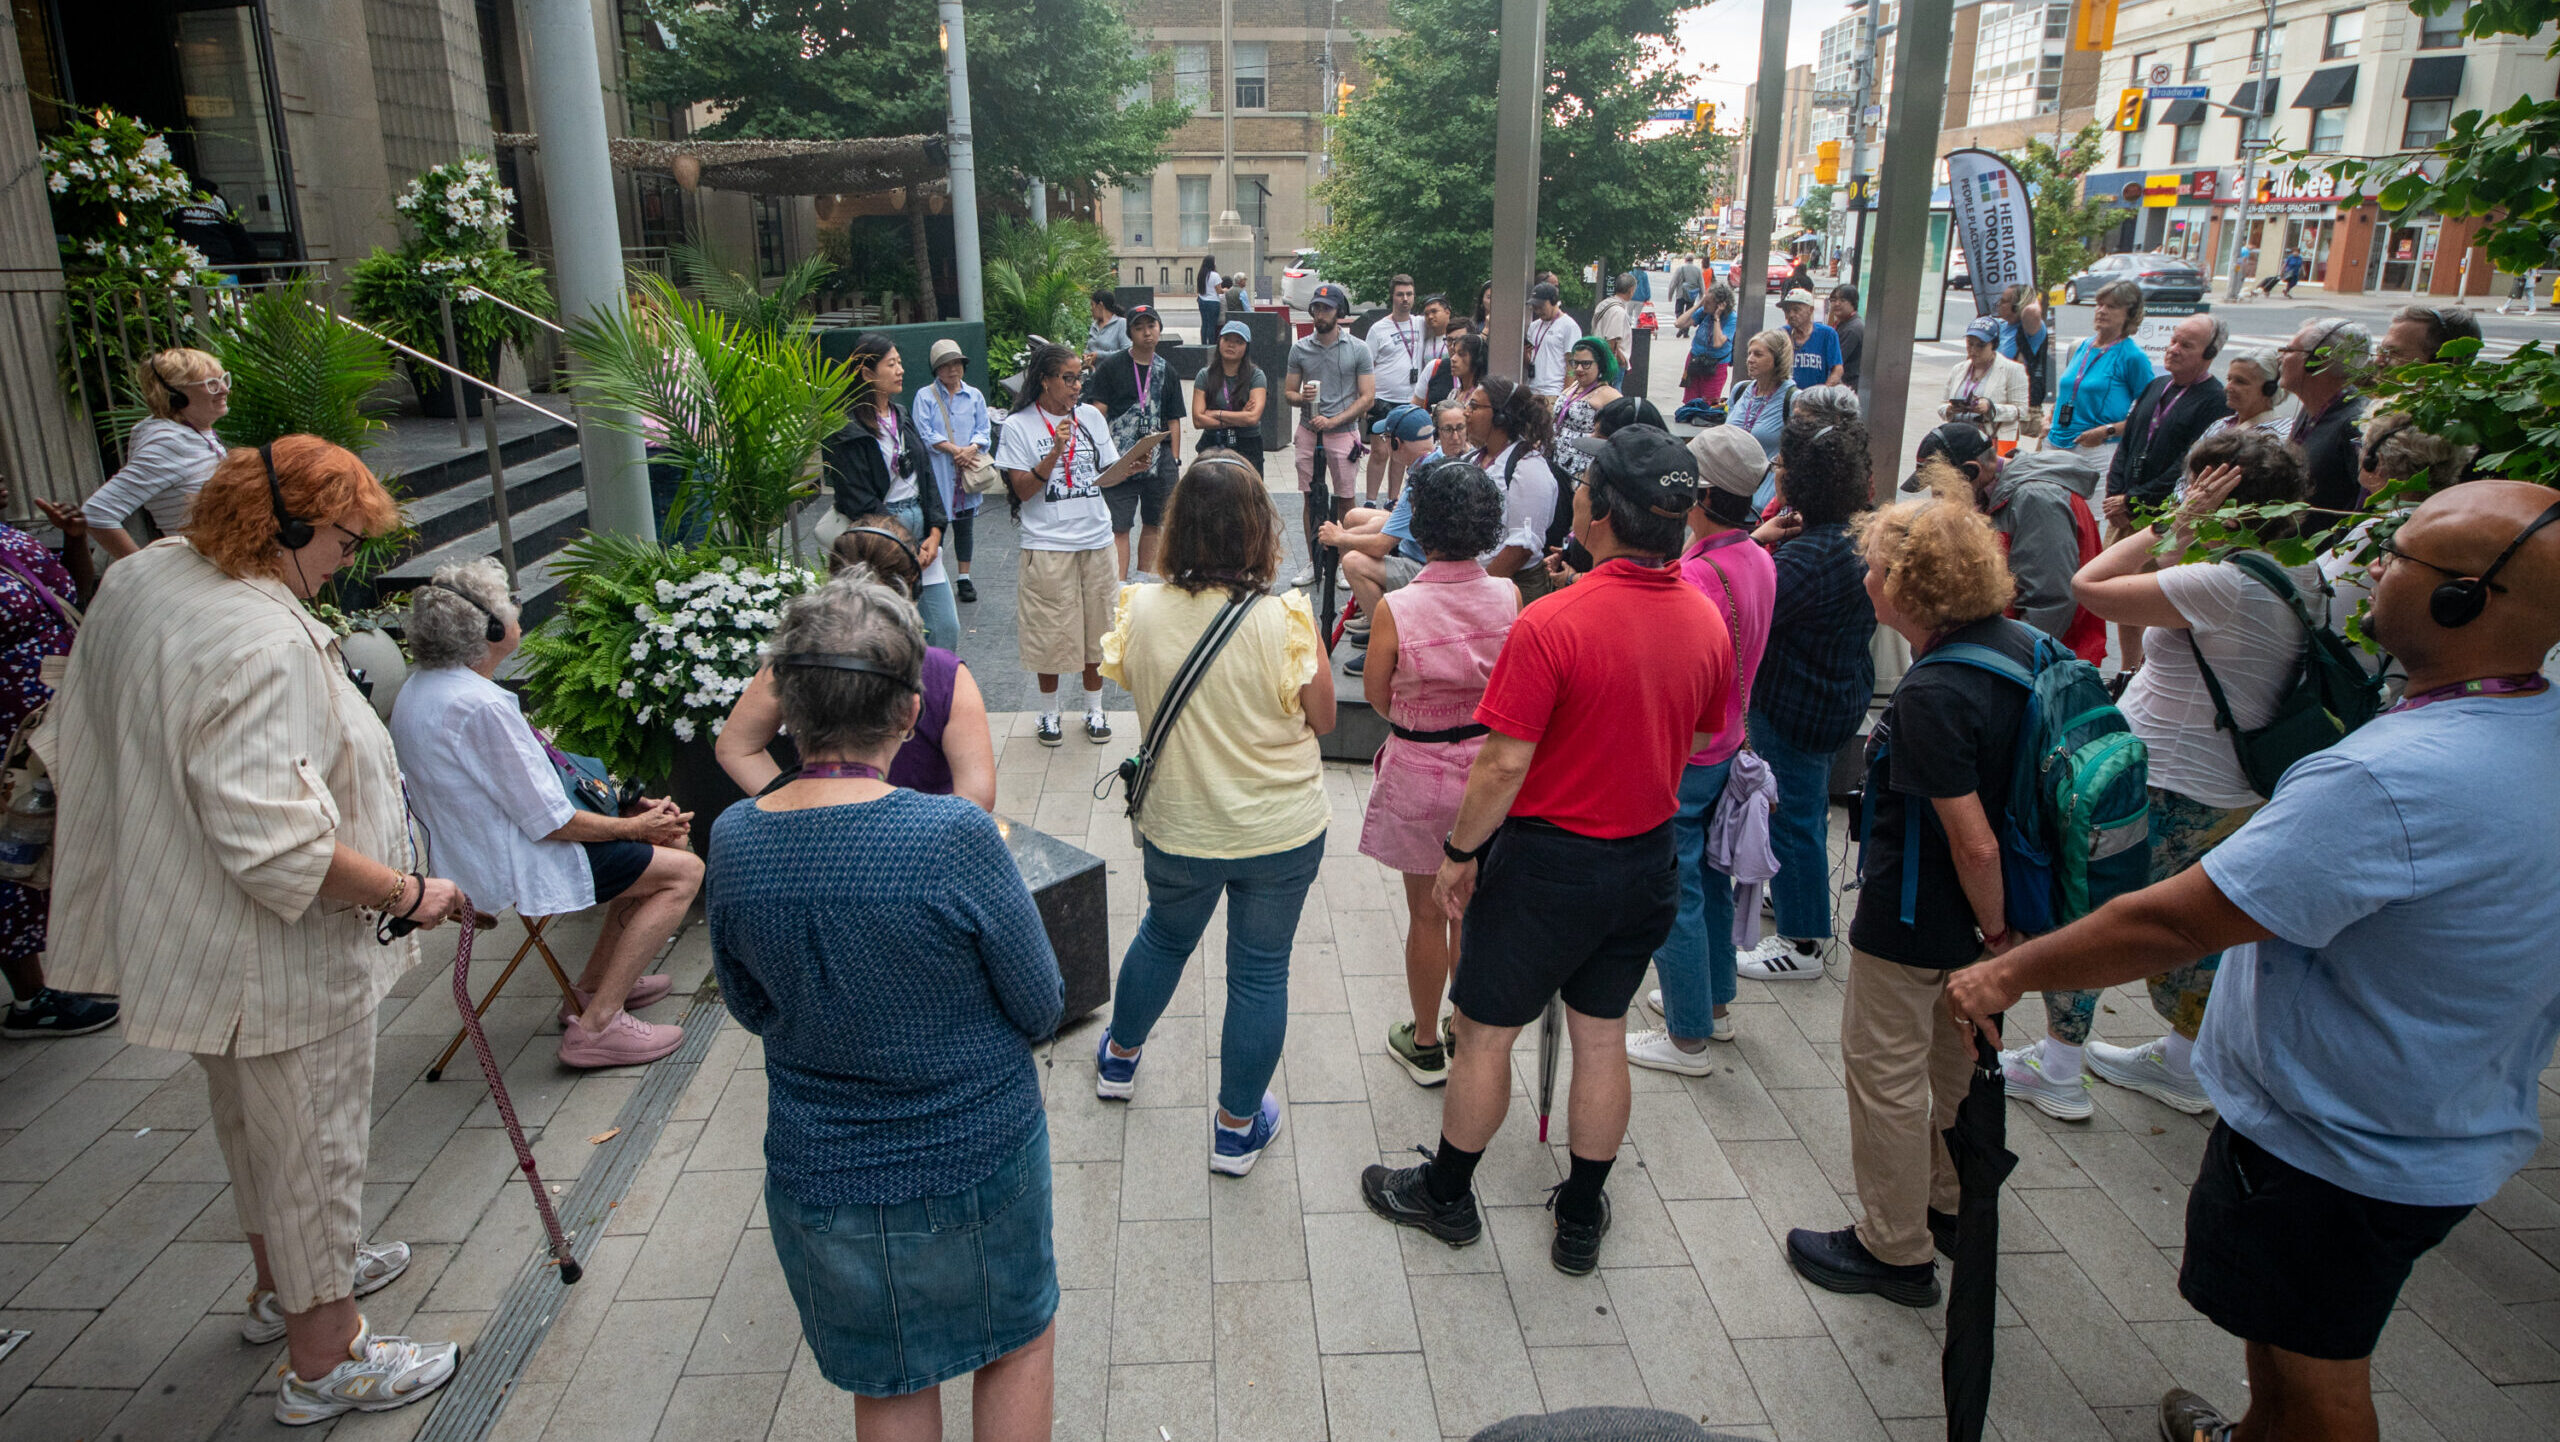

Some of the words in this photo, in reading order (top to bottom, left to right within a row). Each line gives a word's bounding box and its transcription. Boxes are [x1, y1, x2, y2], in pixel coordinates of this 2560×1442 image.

[2151, 88, 2192, 98] Broadway
[1983, 204, 2001, 285] TORONTO
[1999, 202, 2018, 283] HERITAGE
[1659, 471, 1695, 487] ecco
